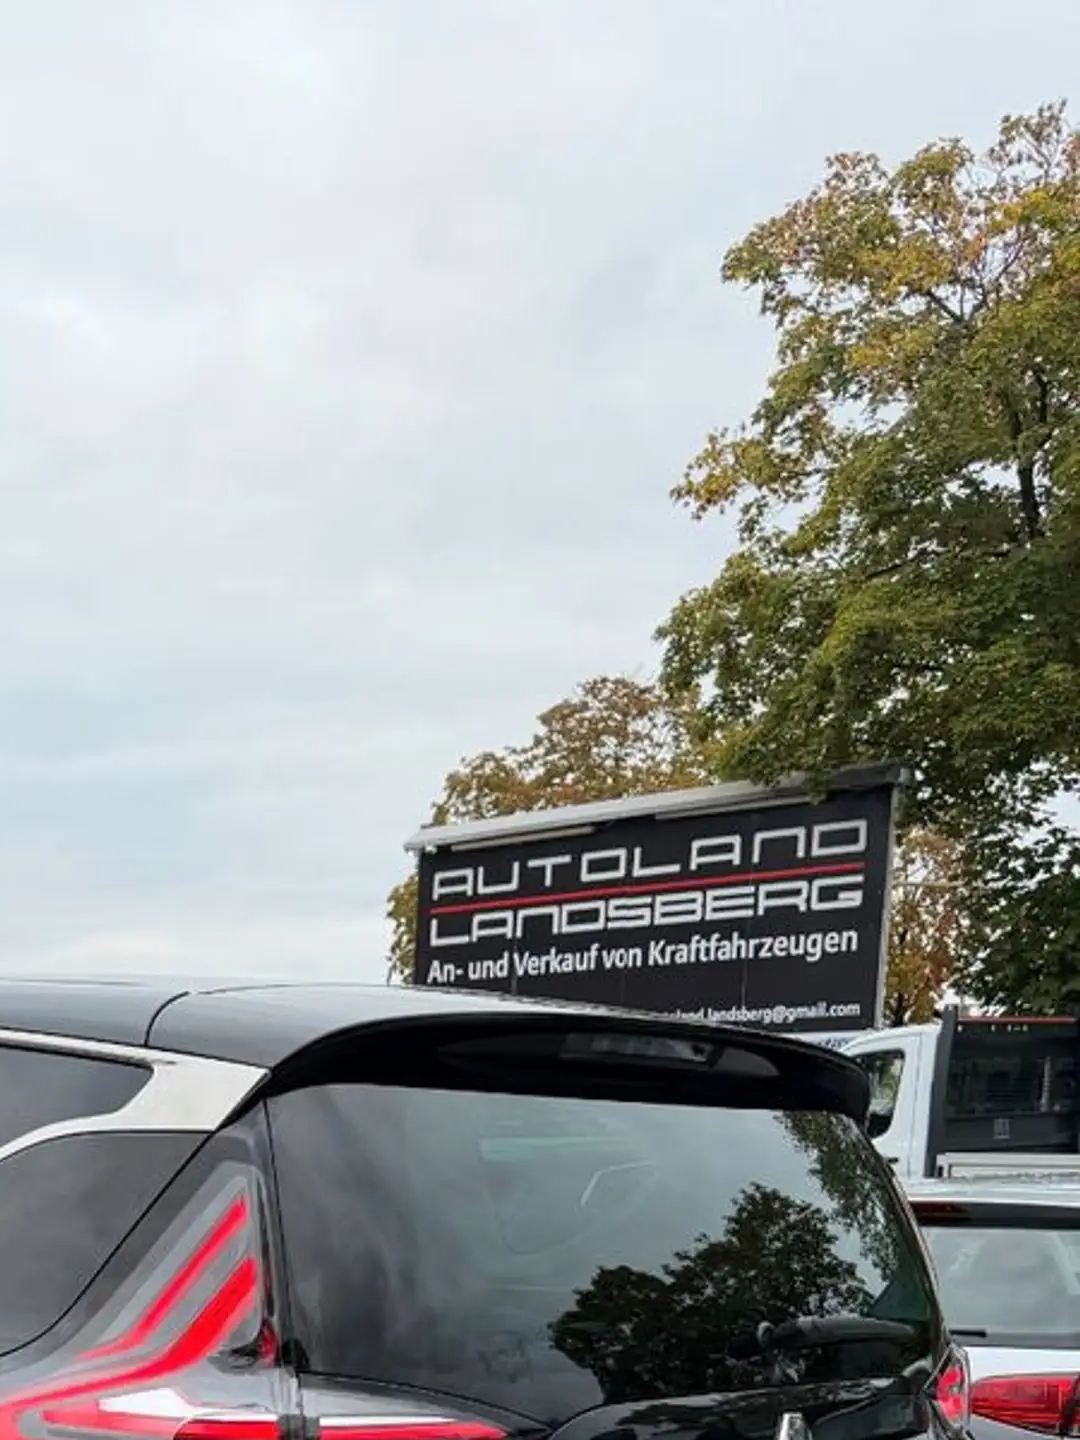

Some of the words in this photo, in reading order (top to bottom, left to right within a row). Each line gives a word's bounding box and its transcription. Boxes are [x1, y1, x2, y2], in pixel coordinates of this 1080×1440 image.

[431, 818, 869, 901] AUTOLAND
[428, 874, 866, 946] LANDSBERG
[428, 961, 464, 984] An-
[468, 951, 509, 978] und
[512, 943, 599, 975] Verkauf
[603, 947, 643, 968] von
[649, 927, 858, 966] Kraftfahrzeugen
